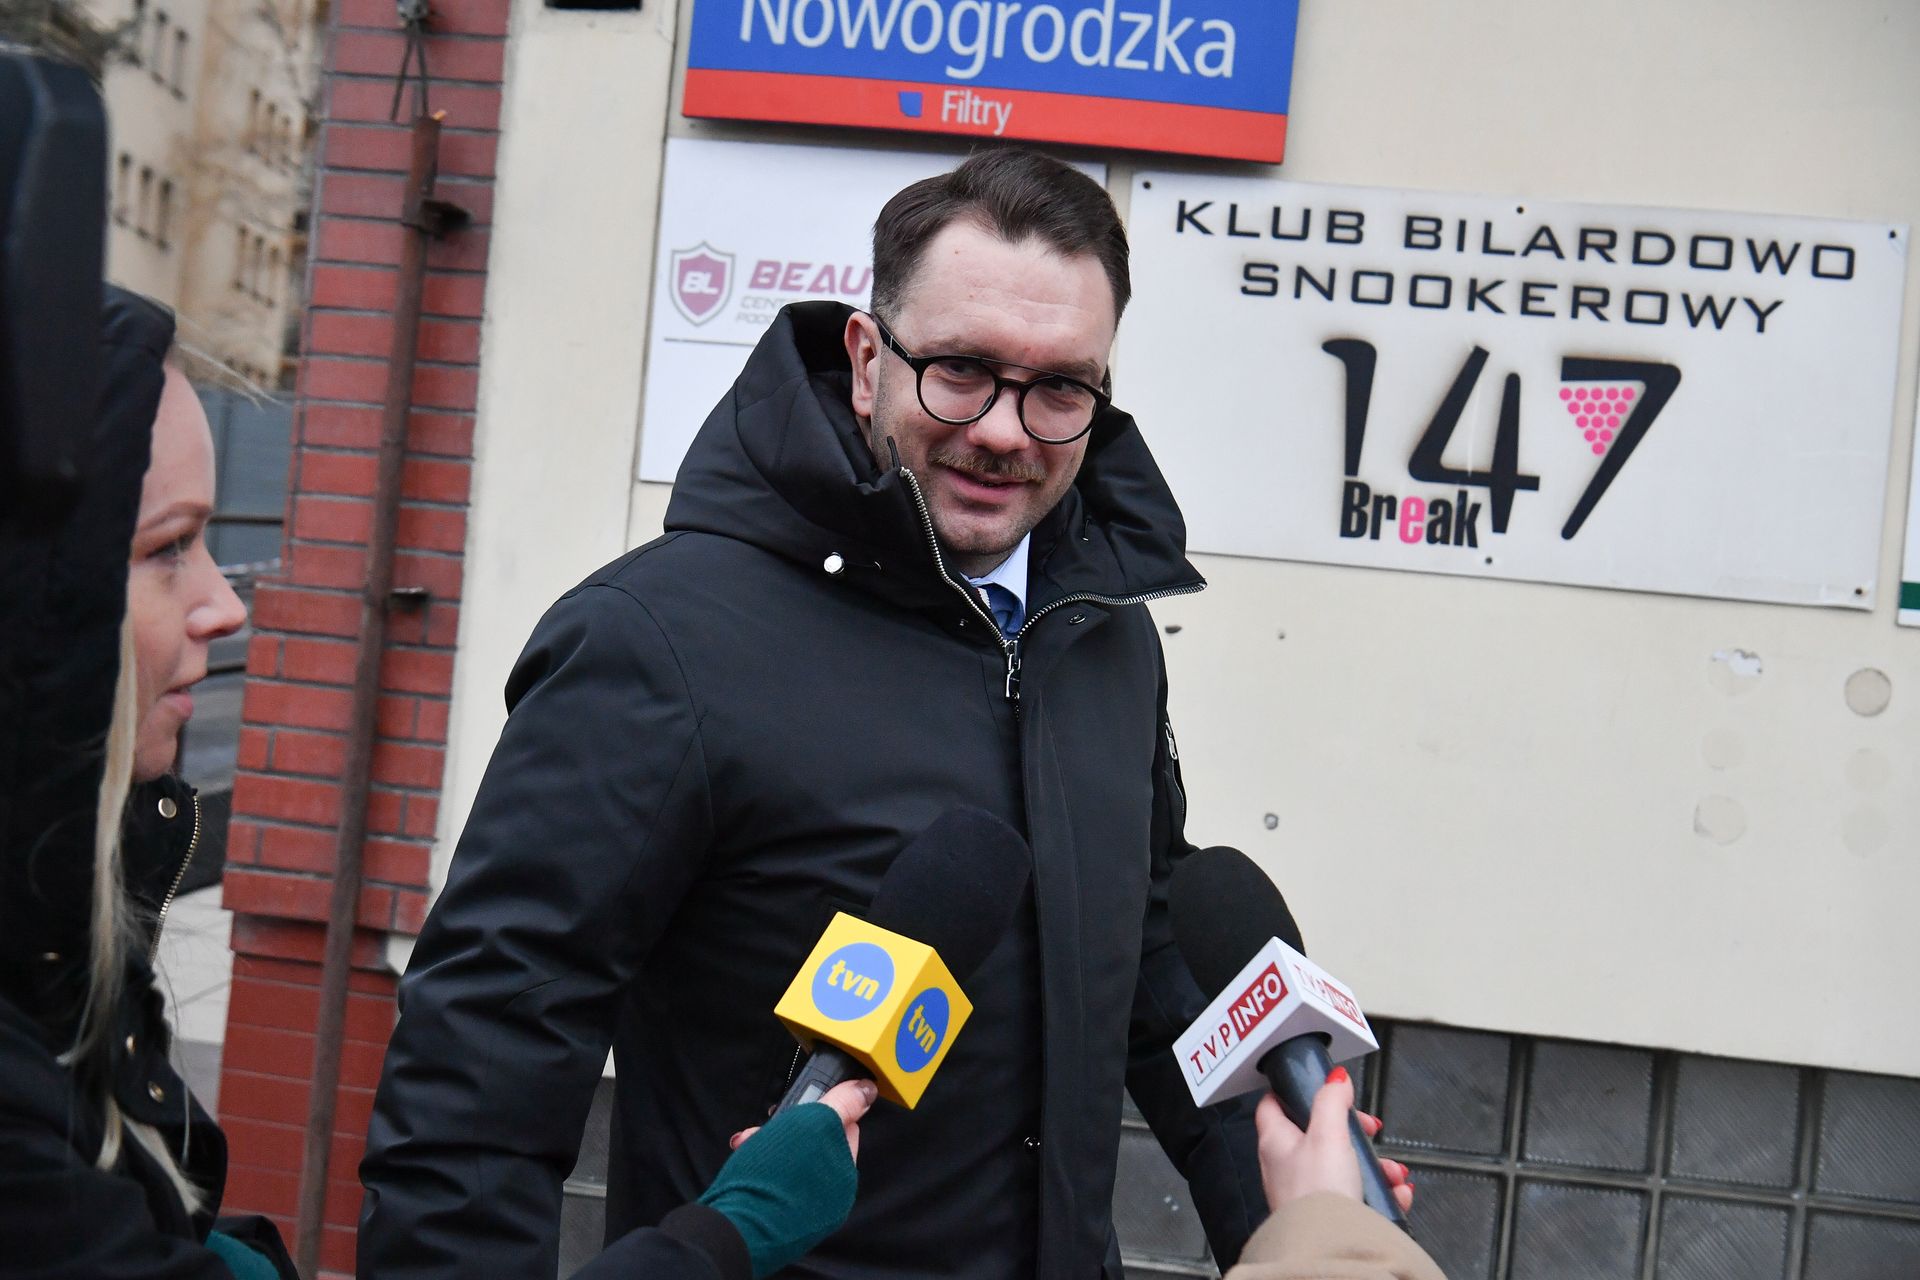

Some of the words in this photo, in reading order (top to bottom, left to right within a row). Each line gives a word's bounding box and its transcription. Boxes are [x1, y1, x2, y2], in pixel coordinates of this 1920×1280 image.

[739, 0, 1237, 79] Nowogrodzka
[941, 90, 1012, 136] Filtry
[1176, 201, 1363, 245] KLUB
[1404, 215, 1854, 281] BILARDOWO
[748, 260, 873, 295] BEAU
[1240, 262, 1783, 334] SNOOKEROWY
[1321, 338, 1682, 541] 147
[1339, 480, 1481, 548] Break
[827, 959, 881, 1001] tvn
[907, 1004, 937, 1053] tvn
[1190, 1022, 1232, 1074] TVP
[1232, 972, 1283, 1033] INFO
